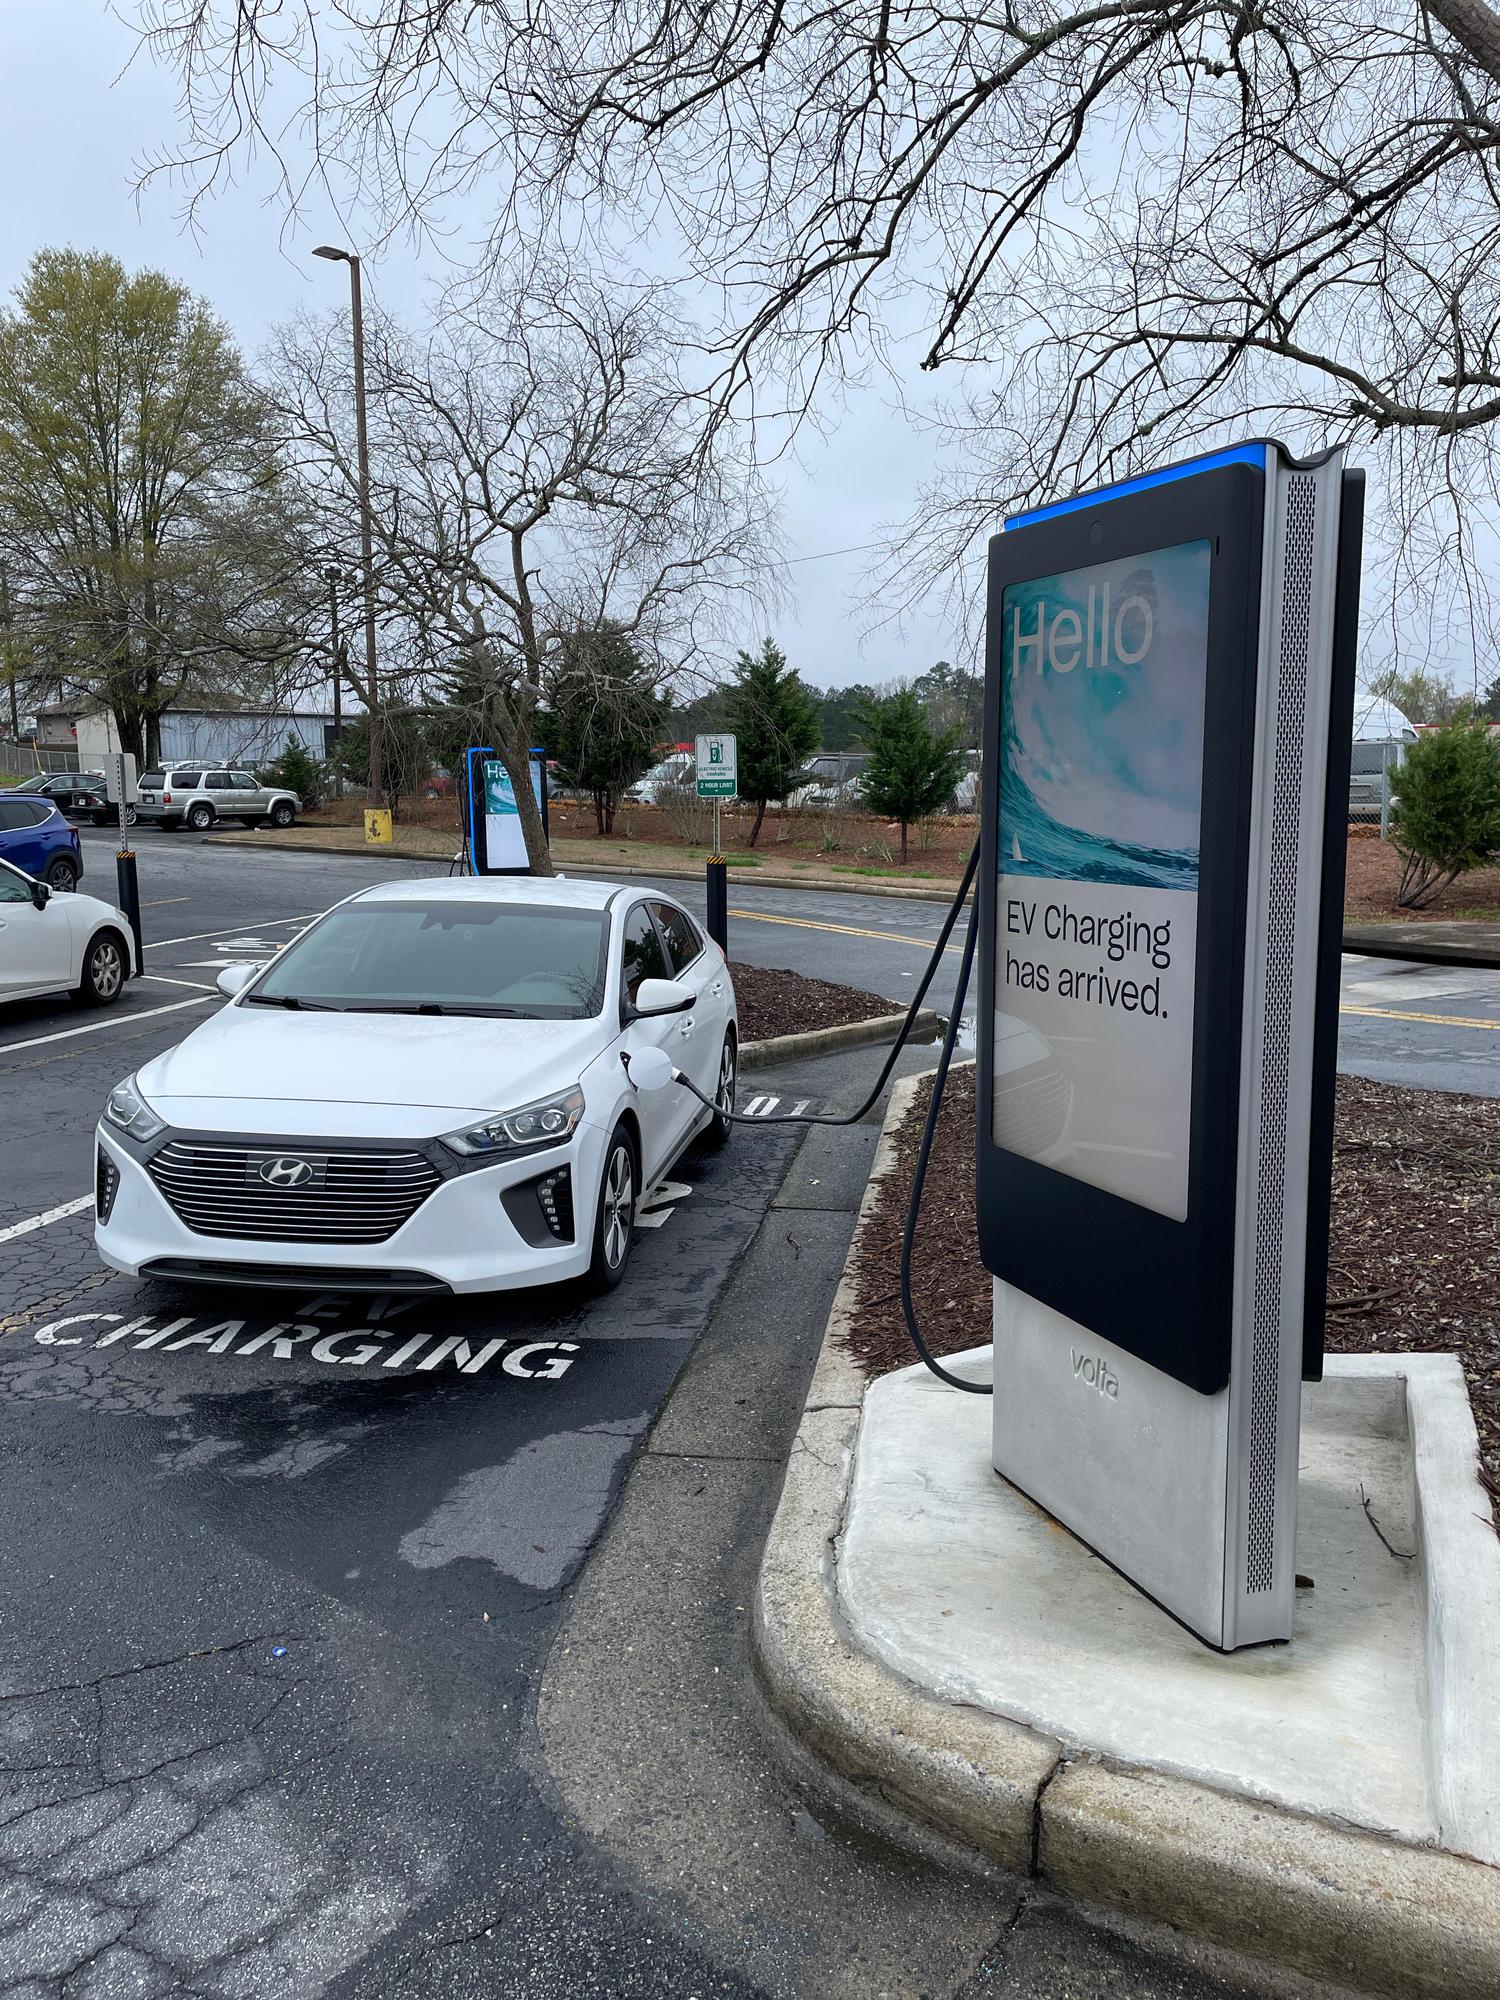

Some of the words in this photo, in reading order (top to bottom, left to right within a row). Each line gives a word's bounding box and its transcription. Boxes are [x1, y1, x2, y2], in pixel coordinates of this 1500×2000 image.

[1012, 581, 1154, 679] Hello
[1006, 900, 1037, 935] EV
[1044, 904, 1171, 969] Charging
[1006, 950, 1050, 993] has
[1057, 970, 1169, 1020] arrived.
[742, 1096, 811, 1117] 01
[34, 1312, 581, 1379] CHARGING
[1070, 1347, 1119, 1401] volta
